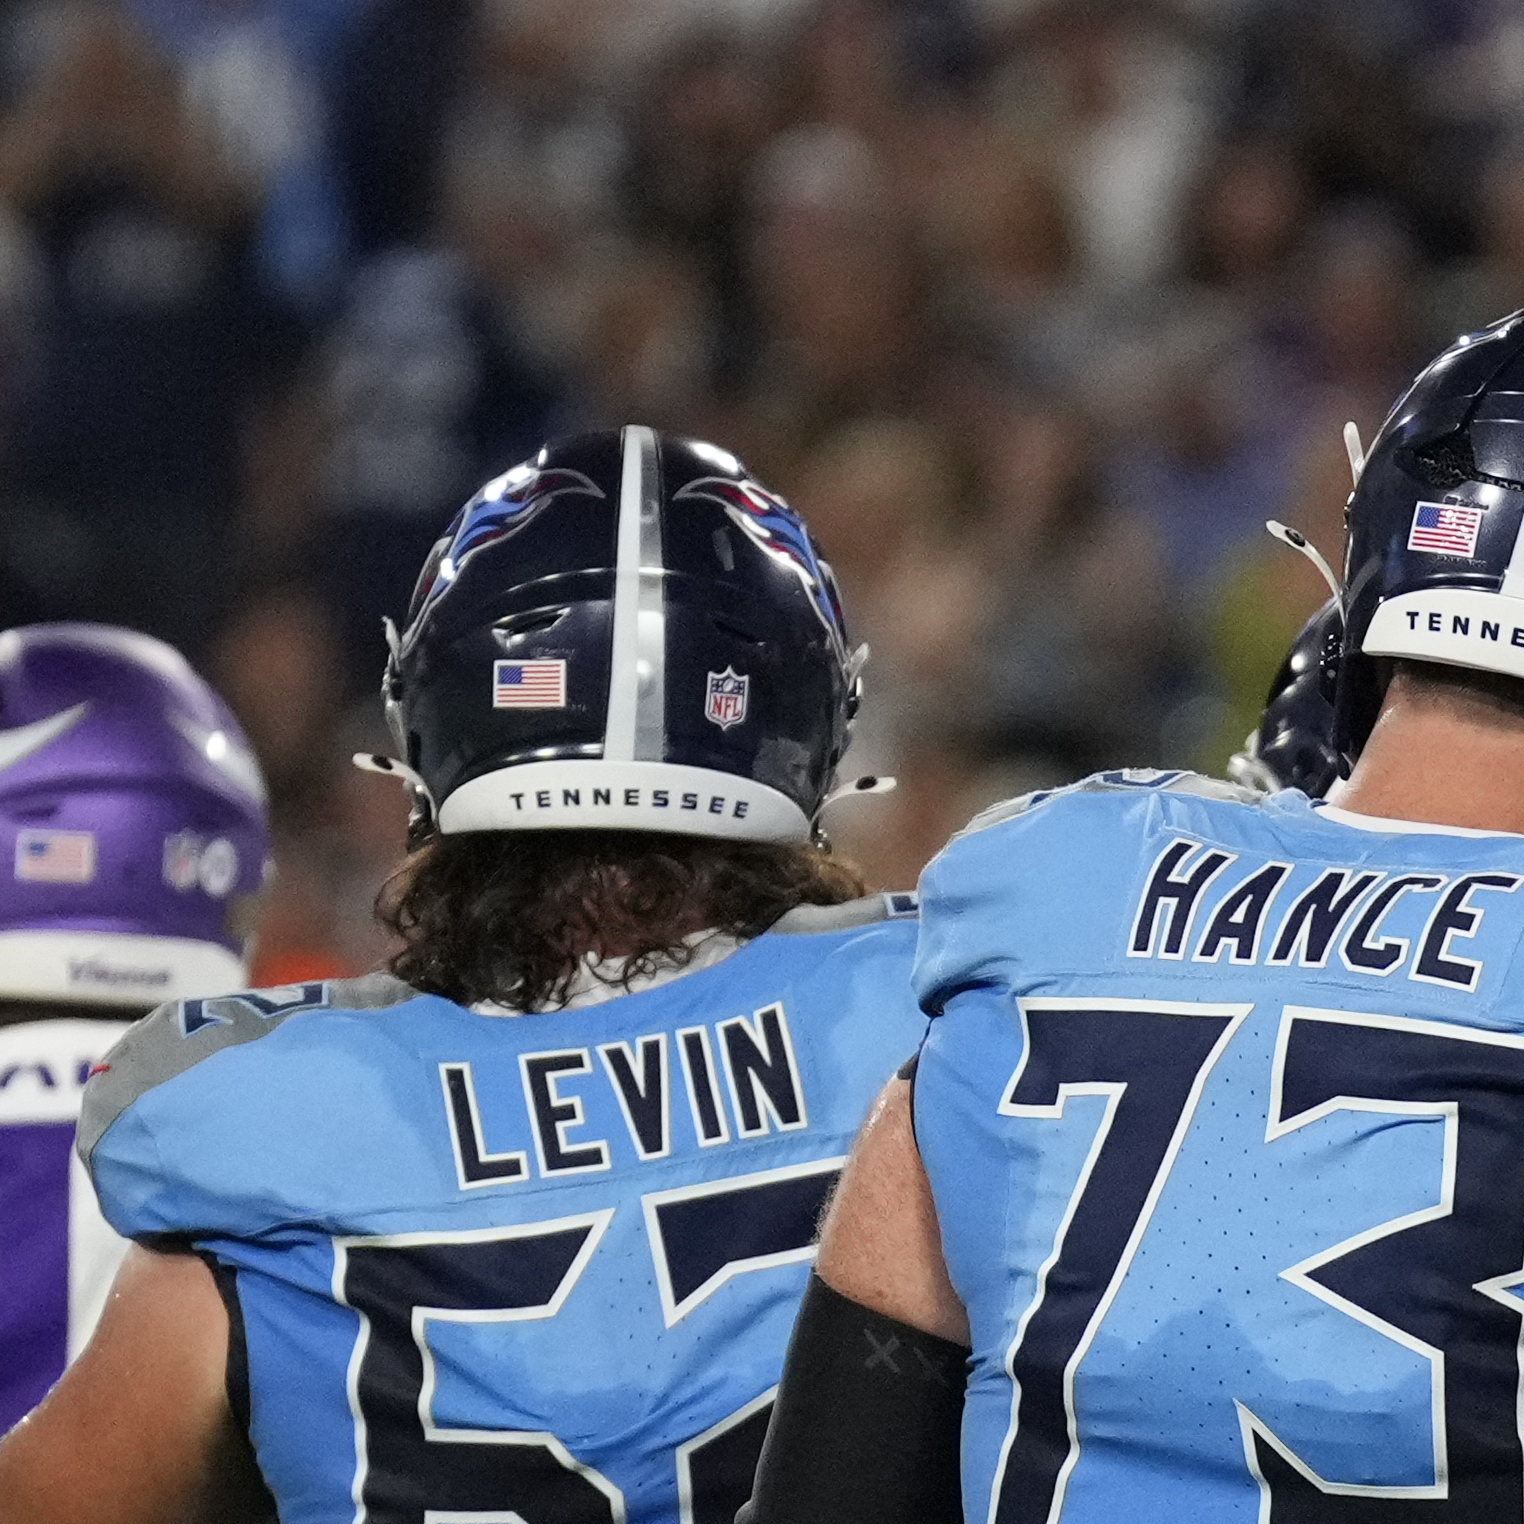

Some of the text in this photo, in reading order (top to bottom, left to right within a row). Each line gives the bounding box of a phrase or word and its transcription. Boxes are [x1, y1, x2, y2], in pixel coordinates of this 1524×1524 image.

[711, 694, 742, 720] NFL
[510, 788, 749, 819] TENNESSEE
[439, 1000, 808, 1190] LEVIN
